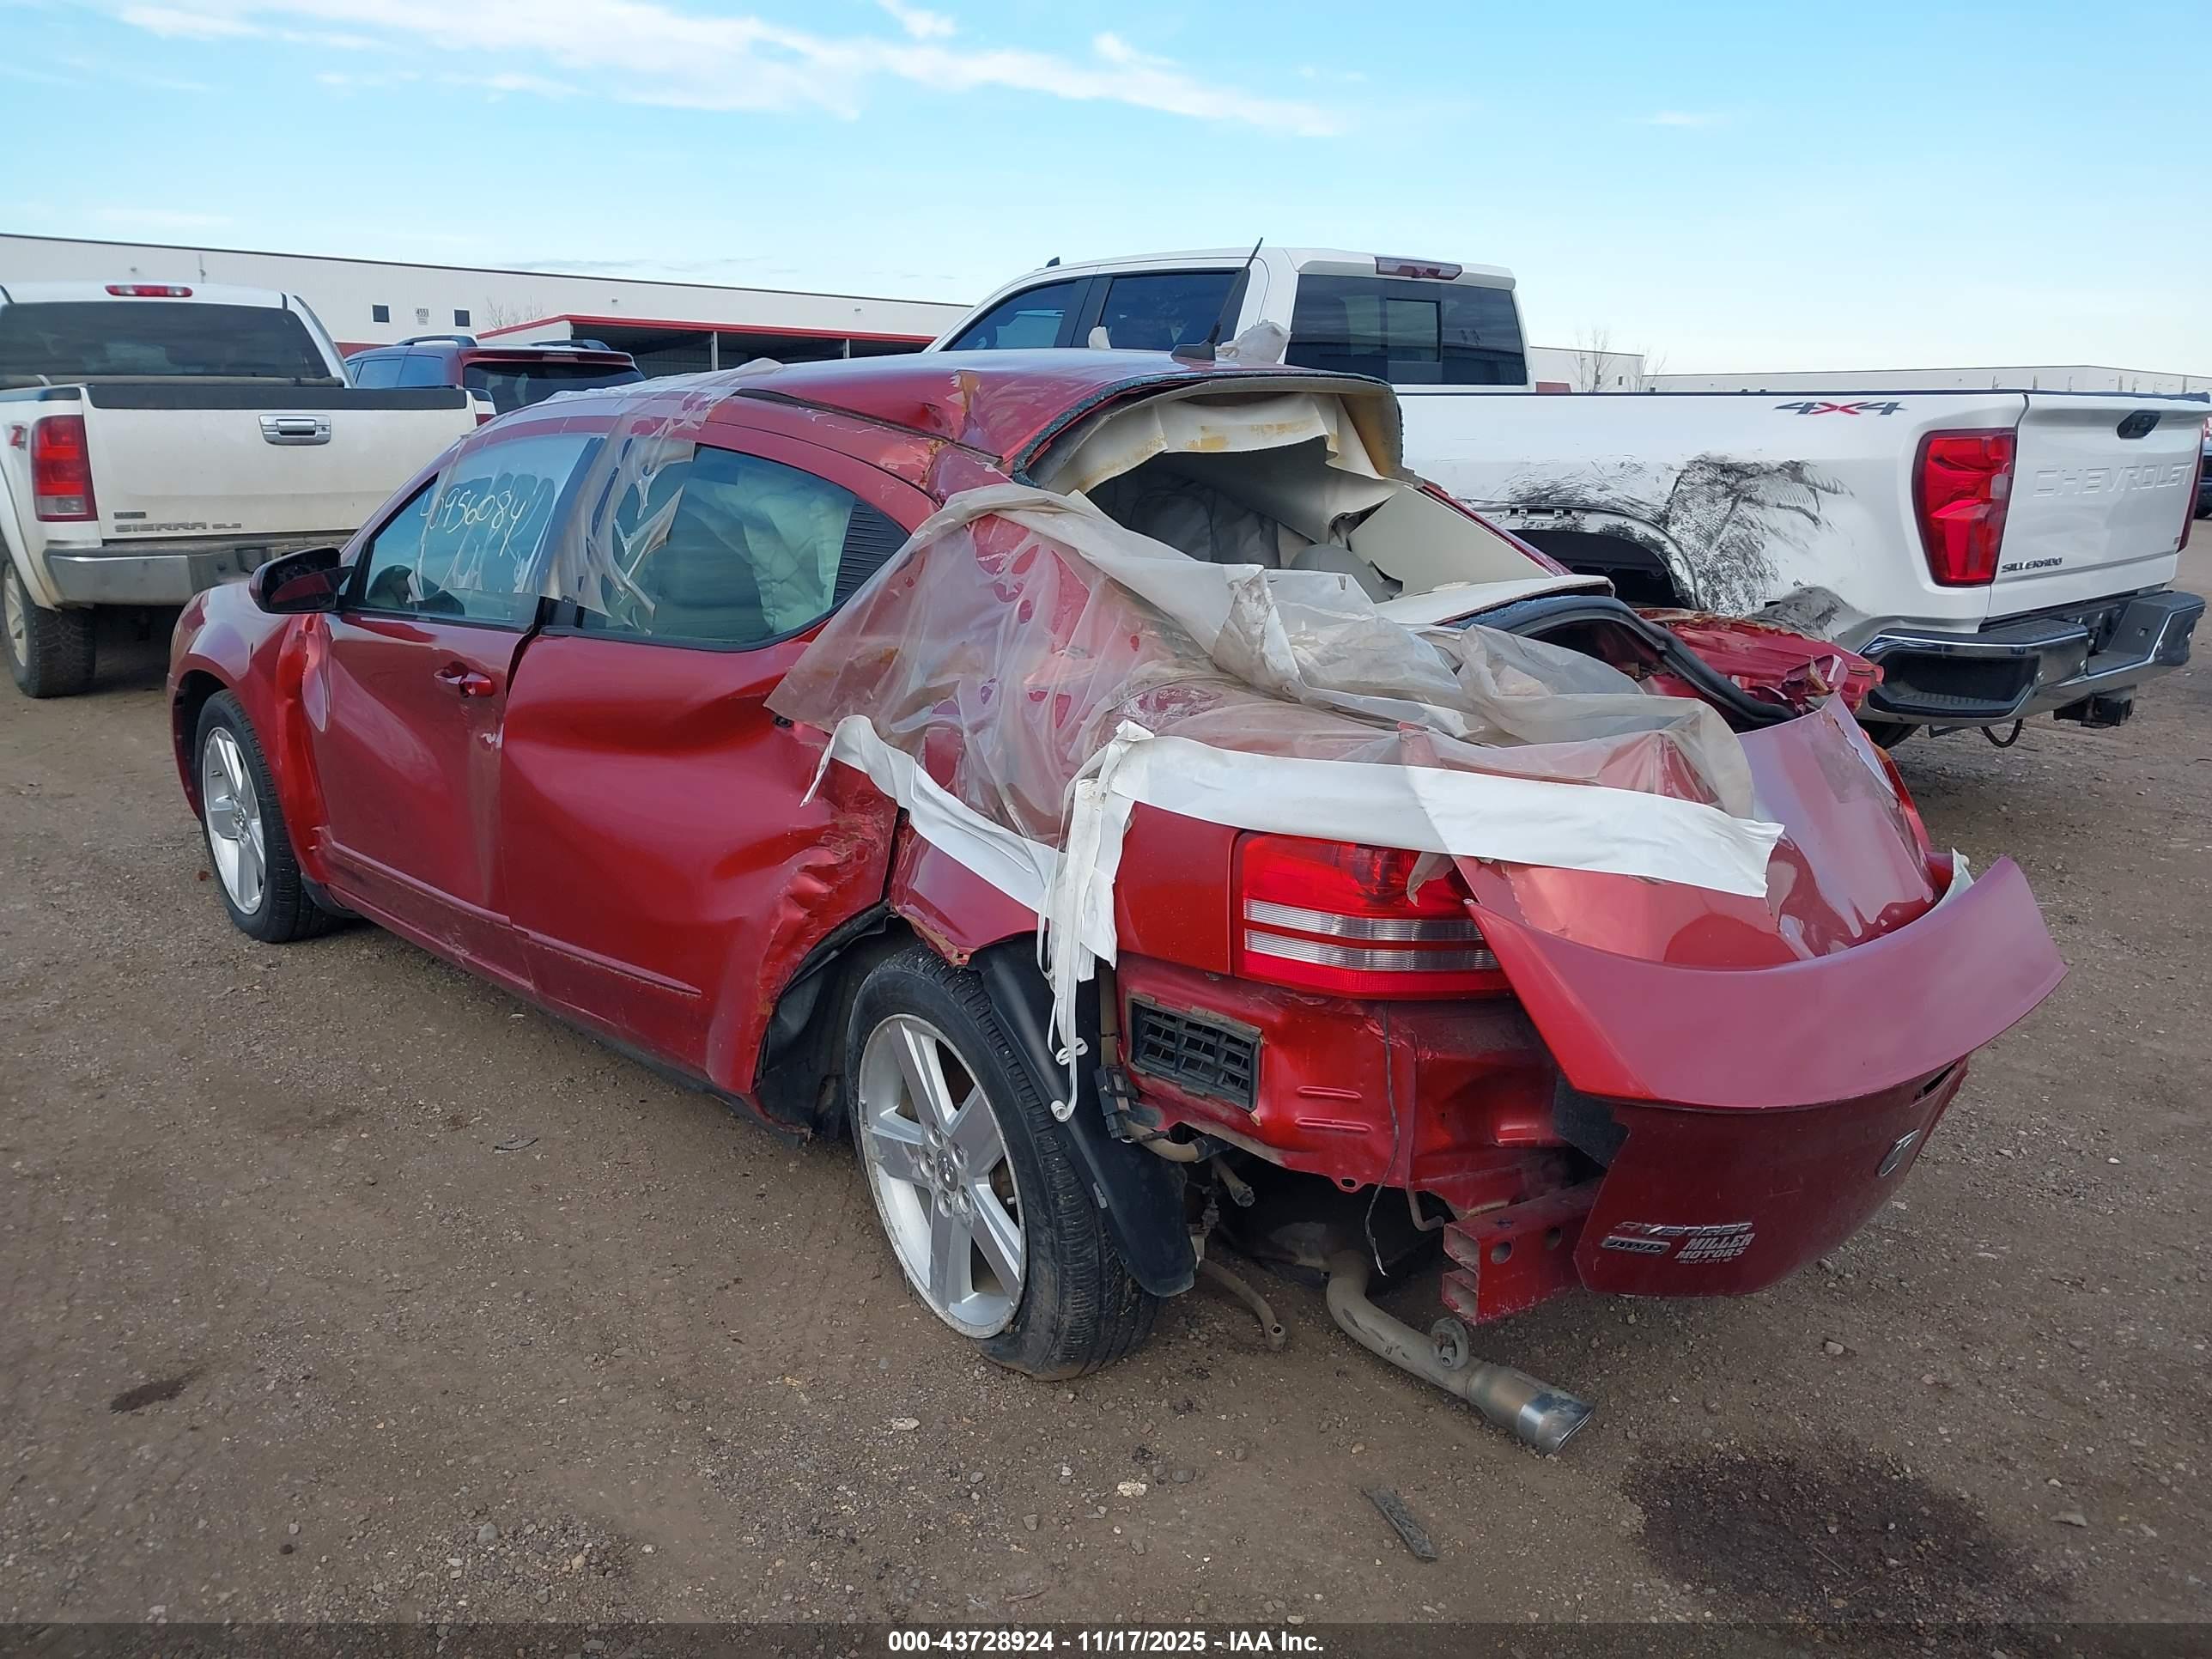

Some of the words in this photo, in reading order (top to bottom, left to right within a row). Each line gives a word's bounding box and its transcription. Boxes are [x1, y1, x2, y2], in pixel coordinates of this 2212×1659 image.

[2033, 462, 2192, 497] CHEVROLET
[114, 522, 207, 532] SIERRA
[2001, 557, 2063, 573] SILVERADO
[1683, 1232, 1756, 1250] MILLER
[1674, 1246, 1747, 1259] MOTORS
